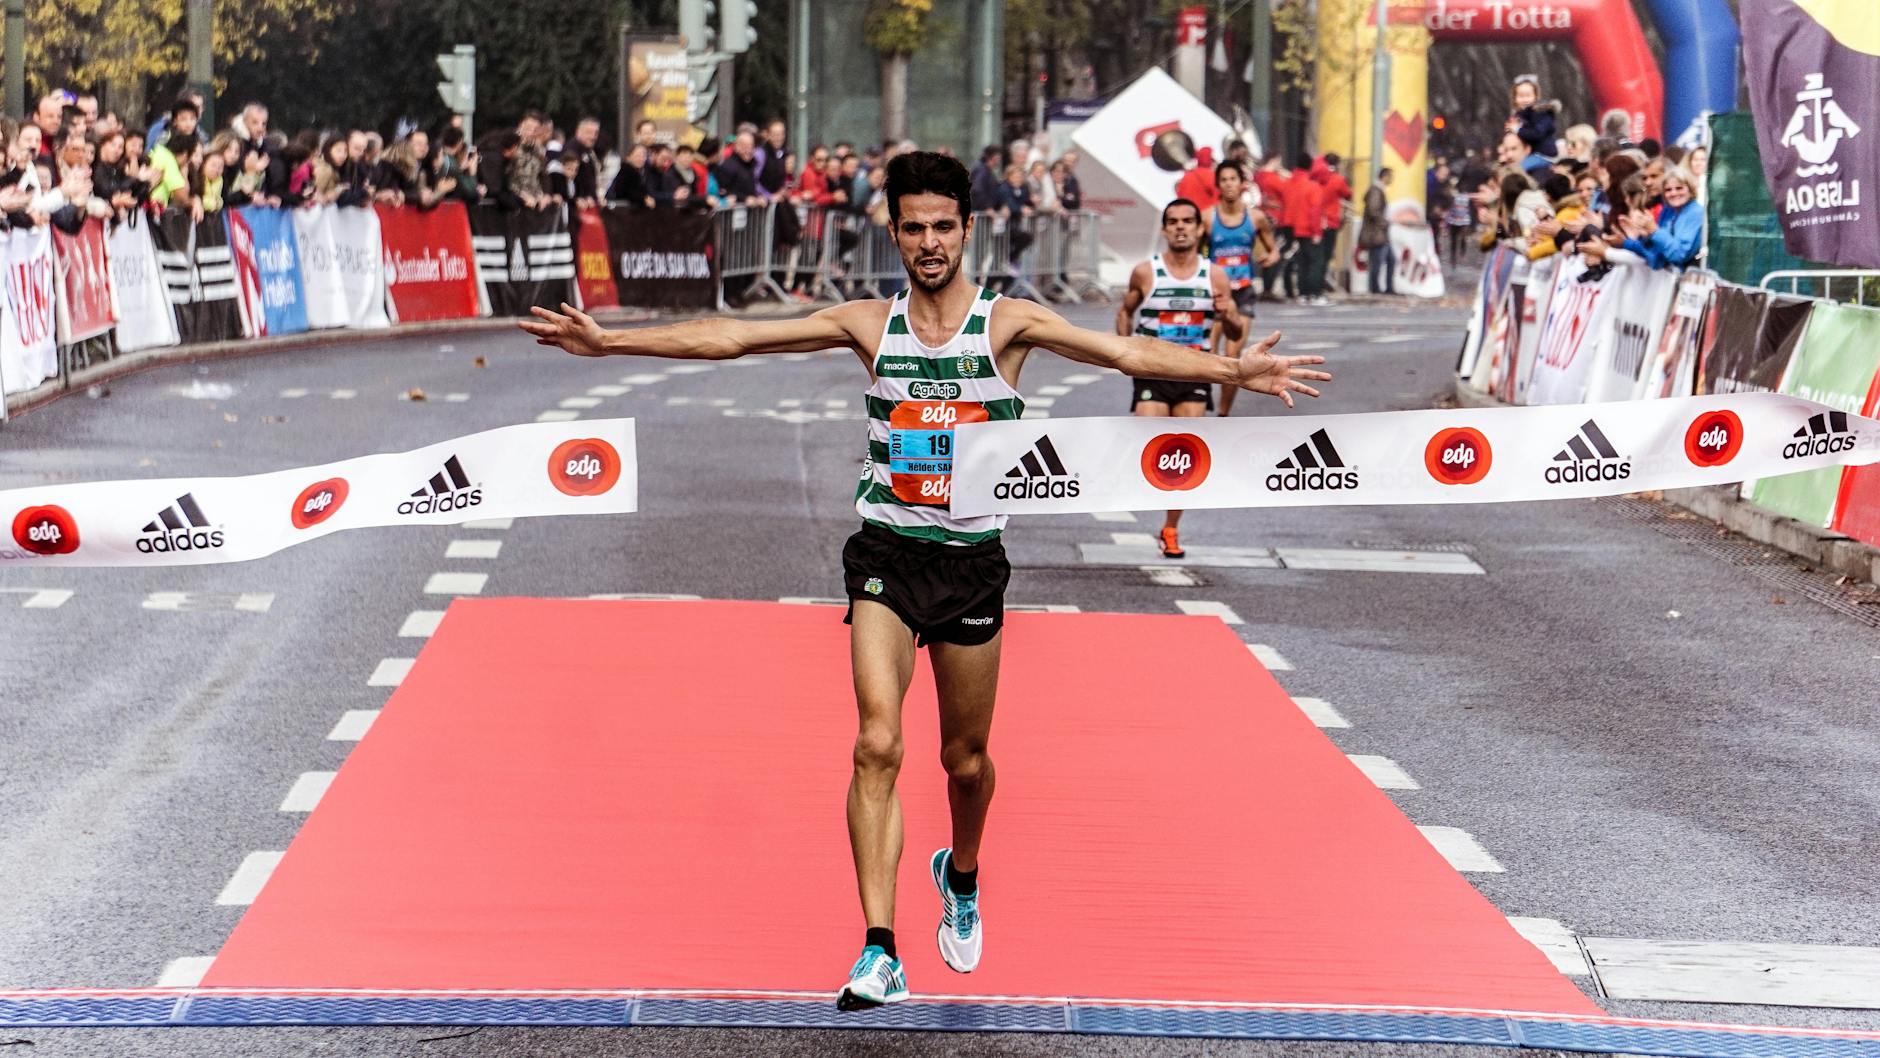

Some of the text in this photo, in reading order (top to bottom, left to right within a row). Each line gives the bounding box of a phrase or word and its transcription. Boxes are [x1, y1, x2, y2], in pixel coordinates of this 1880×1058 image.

[1484, 0, 1572, 30] Totta
[395, 247, 440, 283] Santander
[438, 248, 468, 281] Totta
[621, 252, 631, 278] O
[631, 248, 654, 278] CAFÉ
[666, 252, 686, 278] SUA
[686, 252, 710, 278] VIDA
[912, 382, 957, 399] Agriloja
[920, 402, 957, 428] edp
[892, 433, 902, 455] 2017
[928, 434, 950, 456] 19
[1699, 425, 1728, 451] edp
[1783, 433, 1857, 460] adidas
[565, 454, 601, 480] edp
[908, 463, 936, 473] Hélder
[1158, 449, 1192, 475] edp
[1442, 443, 1476, 468] edp
[1265, 467, 1359, 492] adidas
[1545, 459, 1632, 485] adidas
[993, 476, 1080, 500] adidas
[303, 491, 333, 513] edp
[397, 487, 483, 515] adidas
[28, 521, 62, 543] edp
[136, 529, 225, 554] adidas
